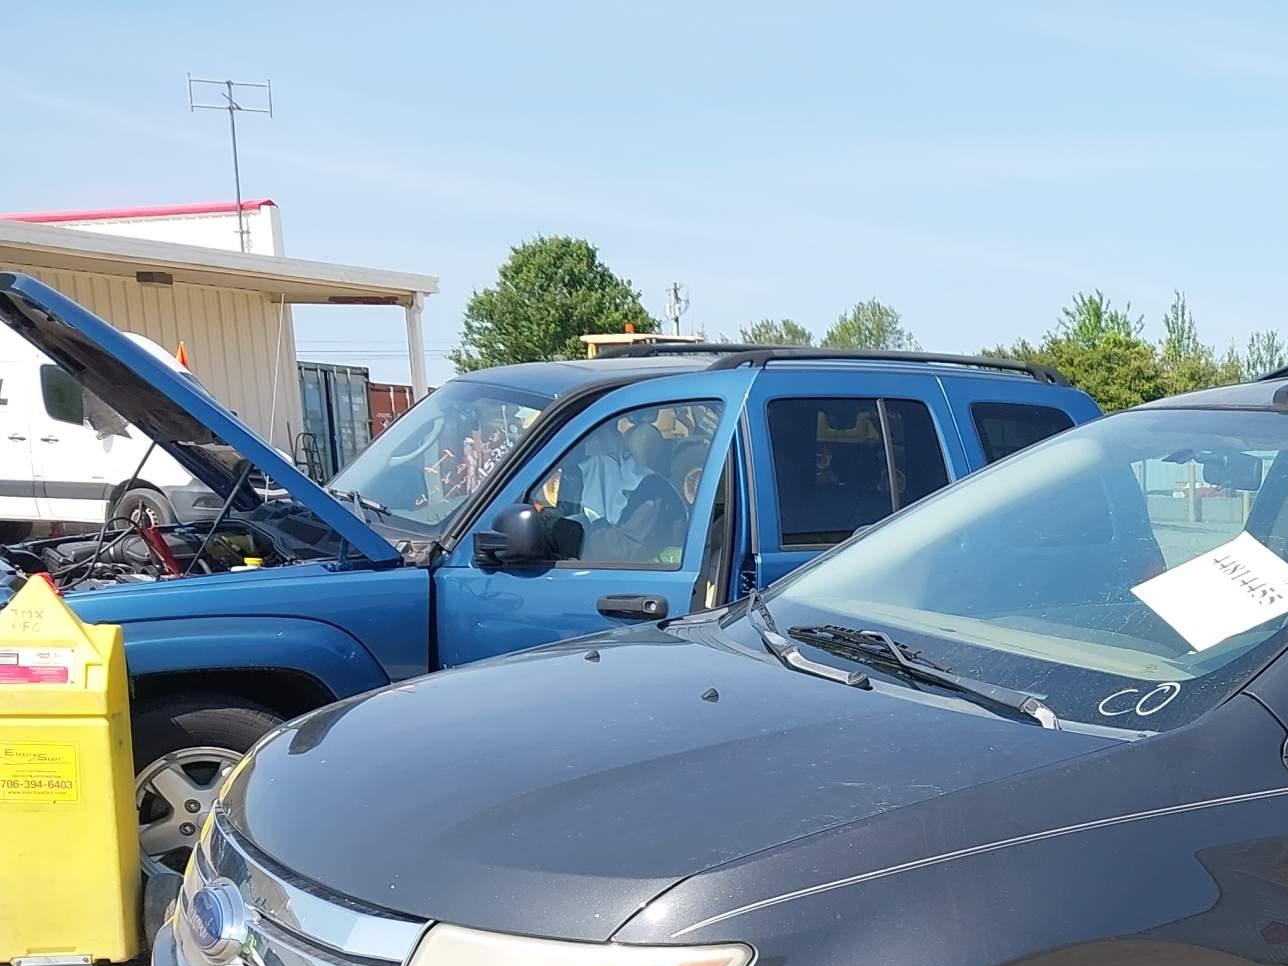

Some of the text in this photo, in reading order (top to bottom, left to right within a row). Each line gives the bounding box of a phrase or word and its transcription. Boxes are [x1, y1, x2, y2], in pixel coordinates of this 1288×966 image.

[1212, 554, 1284, 606] 44814455
[1098, 681, 1181, 716] CO
[1, 779, 73, 790] 706-394-6403
